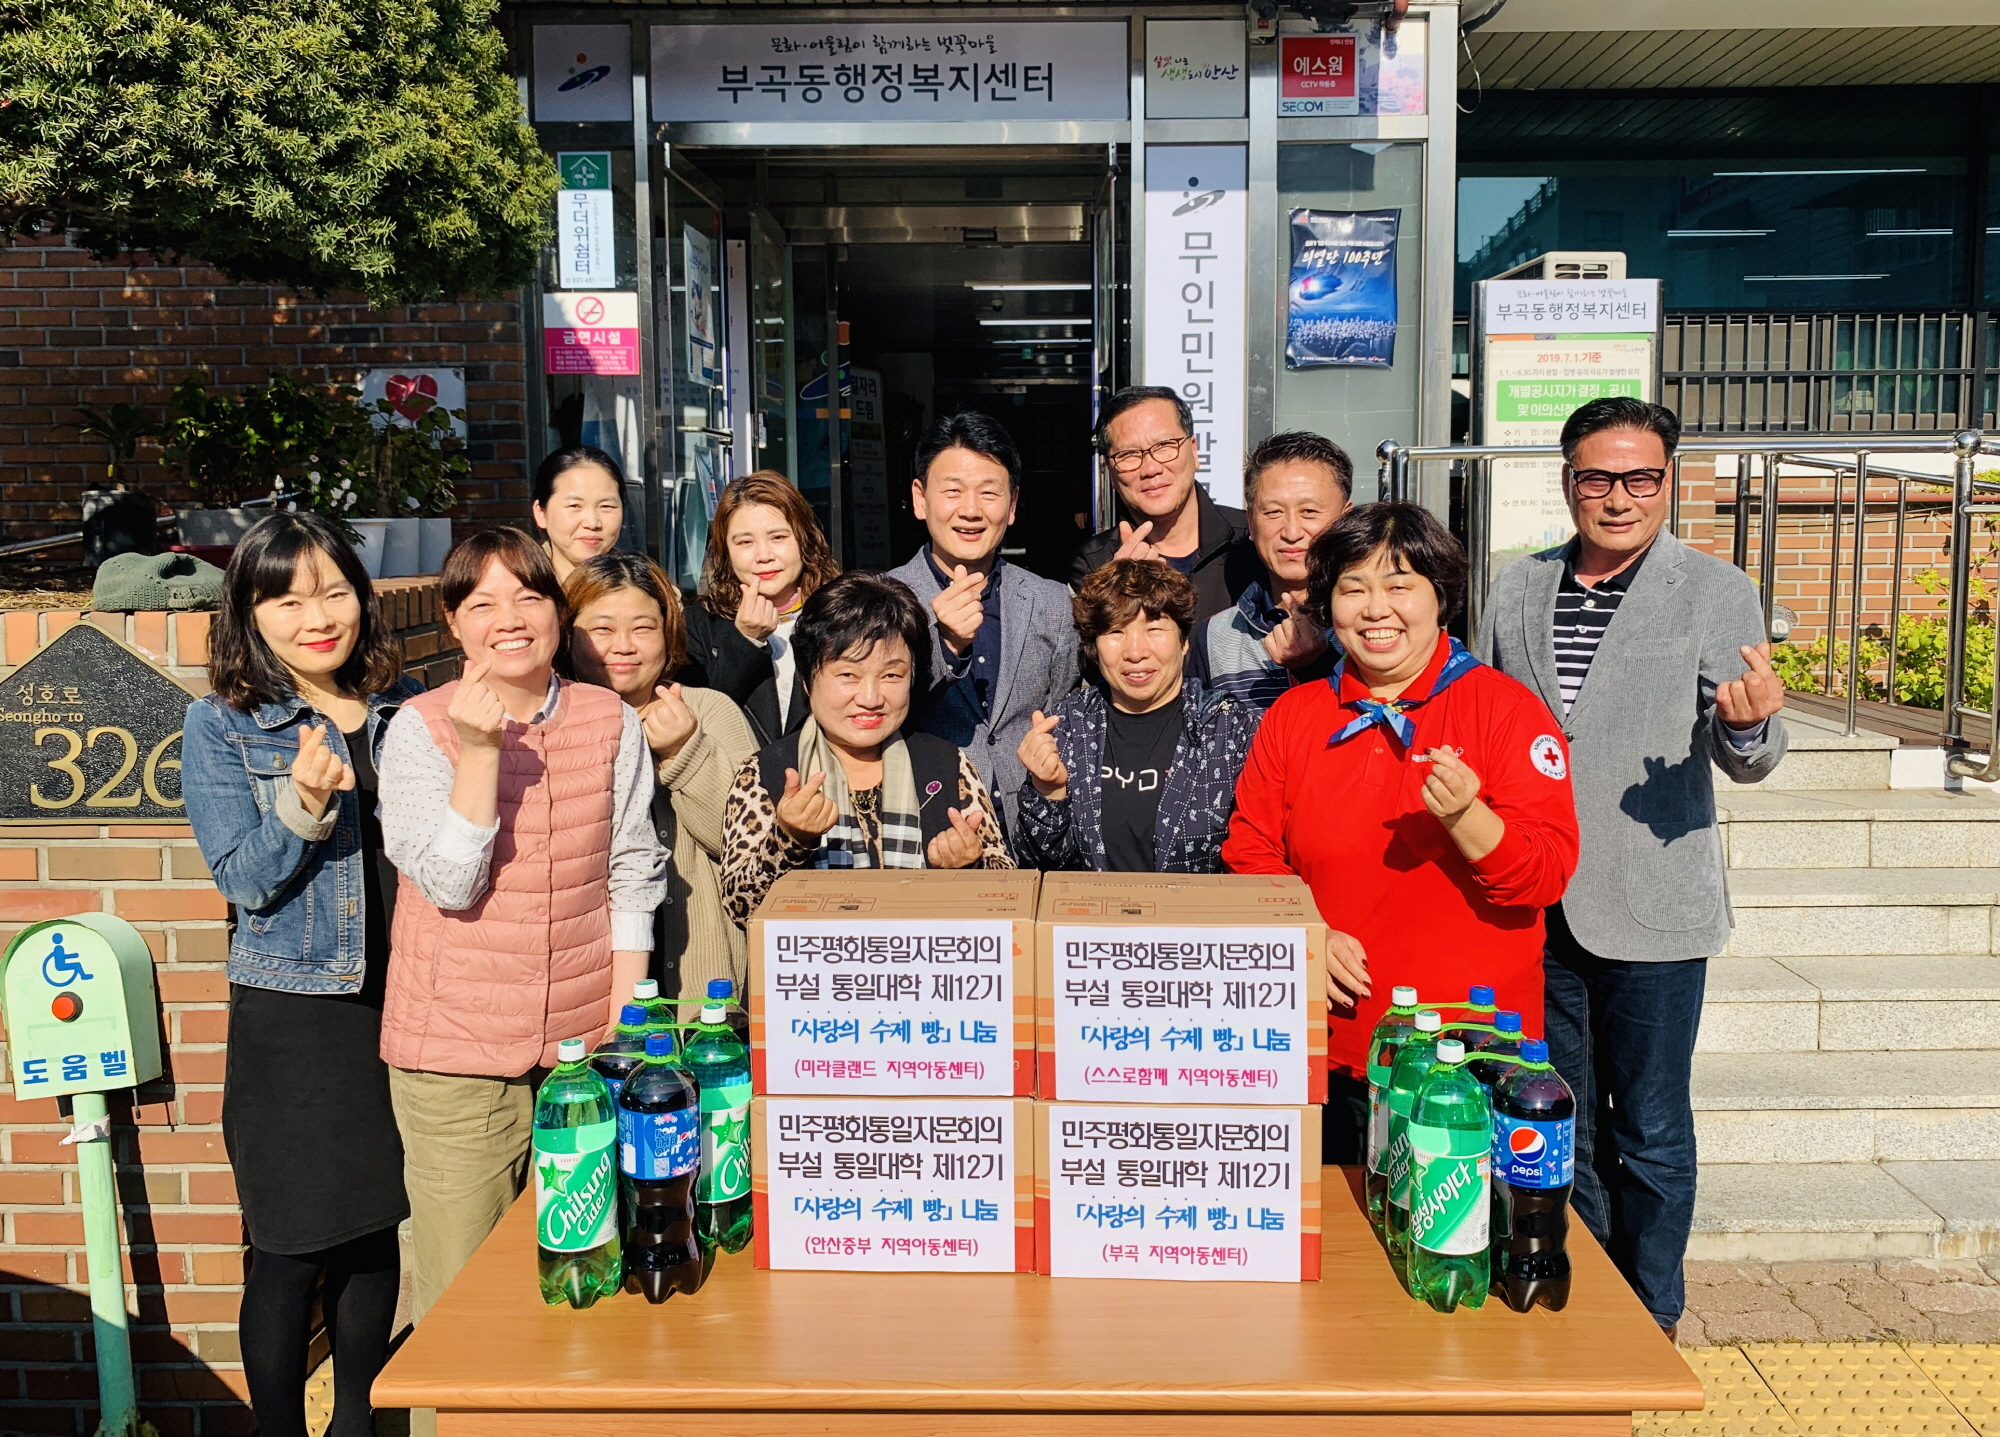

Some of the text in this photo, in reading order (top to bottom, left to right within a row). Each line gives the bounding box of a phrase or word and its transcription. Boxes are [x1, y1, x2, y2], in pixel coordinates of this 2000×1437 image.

[872, 33, 931, 55] 함께하는
[1293, 56, 1343, 76] 에스원
[717, 62, 1053, 104] 부곡동행정복지센터
[1282, 101, 1323, 112] SECOM
[572, 193, 590, 275] 무더위쉼터
[1496, 302, 1647, 321] 부곡동행정복지센터
[563, 331, 621, 345] 금연시설
[851, 374, 877, 397] 일자리
[1508, 384, 1631, 399] 개별공시지가 결정 공시
[856, 401, 874, 421] 드림
[1517, 403, 1529, 417] 및
[16, 683, 85, 706] 성호로
[30, 726, 186, 809] 326
[776, 935, 1002, 964] 민주평화통일자문회의
[1065, 941, 1295, 972] 민주평화통일자문회의
[775, 973, 1002, 1002] 부설 통일대학 제12기
[1065, 979, 1296, 1010] 부설 통일대학 제12기
[869, 1018, 911, 1044] 수제
[960, 1019, 998, 1044] 나눔
[1160, 1026, 1203, 1052] 수제
[1253, 1027, 1291, 1052] 나눔
[22, 1050, 127, 1085] 도움벨
[794, 1059, 985, 1080] (미라클랜드 지역아동센터)
[1084, 1066, 1278, 1089] (스스로함께 지역아동센터)
[779, 1114, 1003, 1144] 민주평화통일자문회의
[1061, 1120, 1290, 1152] 민주평화통일자문회의
[670, 1143, 682, 1156] IT
[777, 1151, 822, 1179] 부설
[833, 1152, 924, 1180] 통일대학
[932, 1153, 1003, 1181] 제12기
[1060, 1158, 1290, 1190] 부설 통일대학 제12기
[1511, 1165, 1544, 1177] pepsi
[547, 1151, 612, 1246] Chilsung
[577, 1182, 606, 1236] Cider
[871, 1197, 913, 1222] 수제
[961, 1198, 999, 1222] 나눔
[1155, 1205, 1197, 1230] 수제
[1246, 1206, 1286, 1231] 나눔
[804, 1236, 979, 1258] (안산중부 지역아동센터)
[1102, 1243, 1248, 1267] (부곡 지역아동센터)
